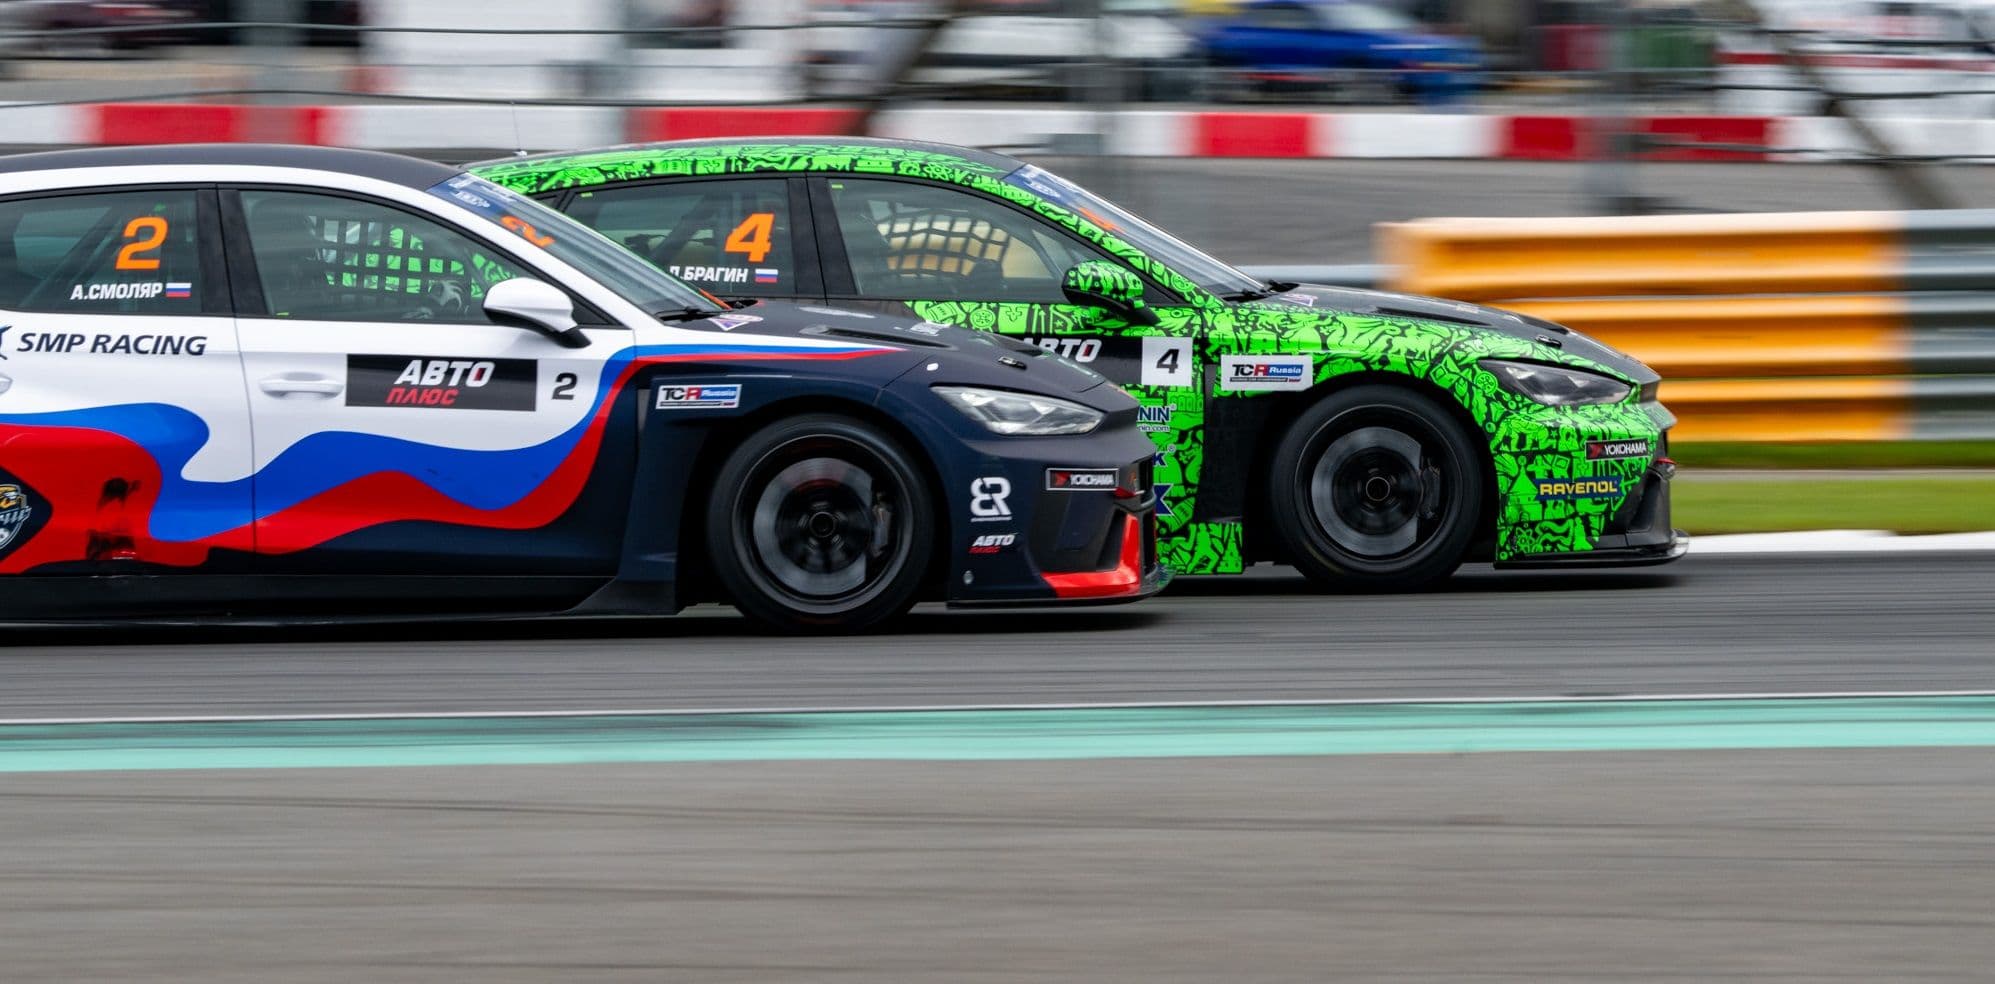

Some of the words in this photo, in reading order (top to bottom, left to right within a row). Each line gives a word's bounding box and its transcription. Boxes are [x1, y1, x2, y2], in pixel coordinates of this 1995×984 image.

[115, 216, 168, 270] 2
[724, 213, 774, 262] 4
[70, 282, 163, 300] А.СМОЛЯР
[16, 332, 86, 353] SMP
[90, 334, 208, 356] RACING
[1155, 348, 1180, 374] 4
[1232, 364, 1268, 376] TCR
[1269, 366, 1302, 374] Russia
[394, 360, 496, 388] АВТО
[385, 387, 460, 406] ПЛЮС
[551, 373, 578, 401] 2
[1604, 442, 1647, 455] YOKOHAMA
[1540, 481, 1618, 496] RAVENOL
